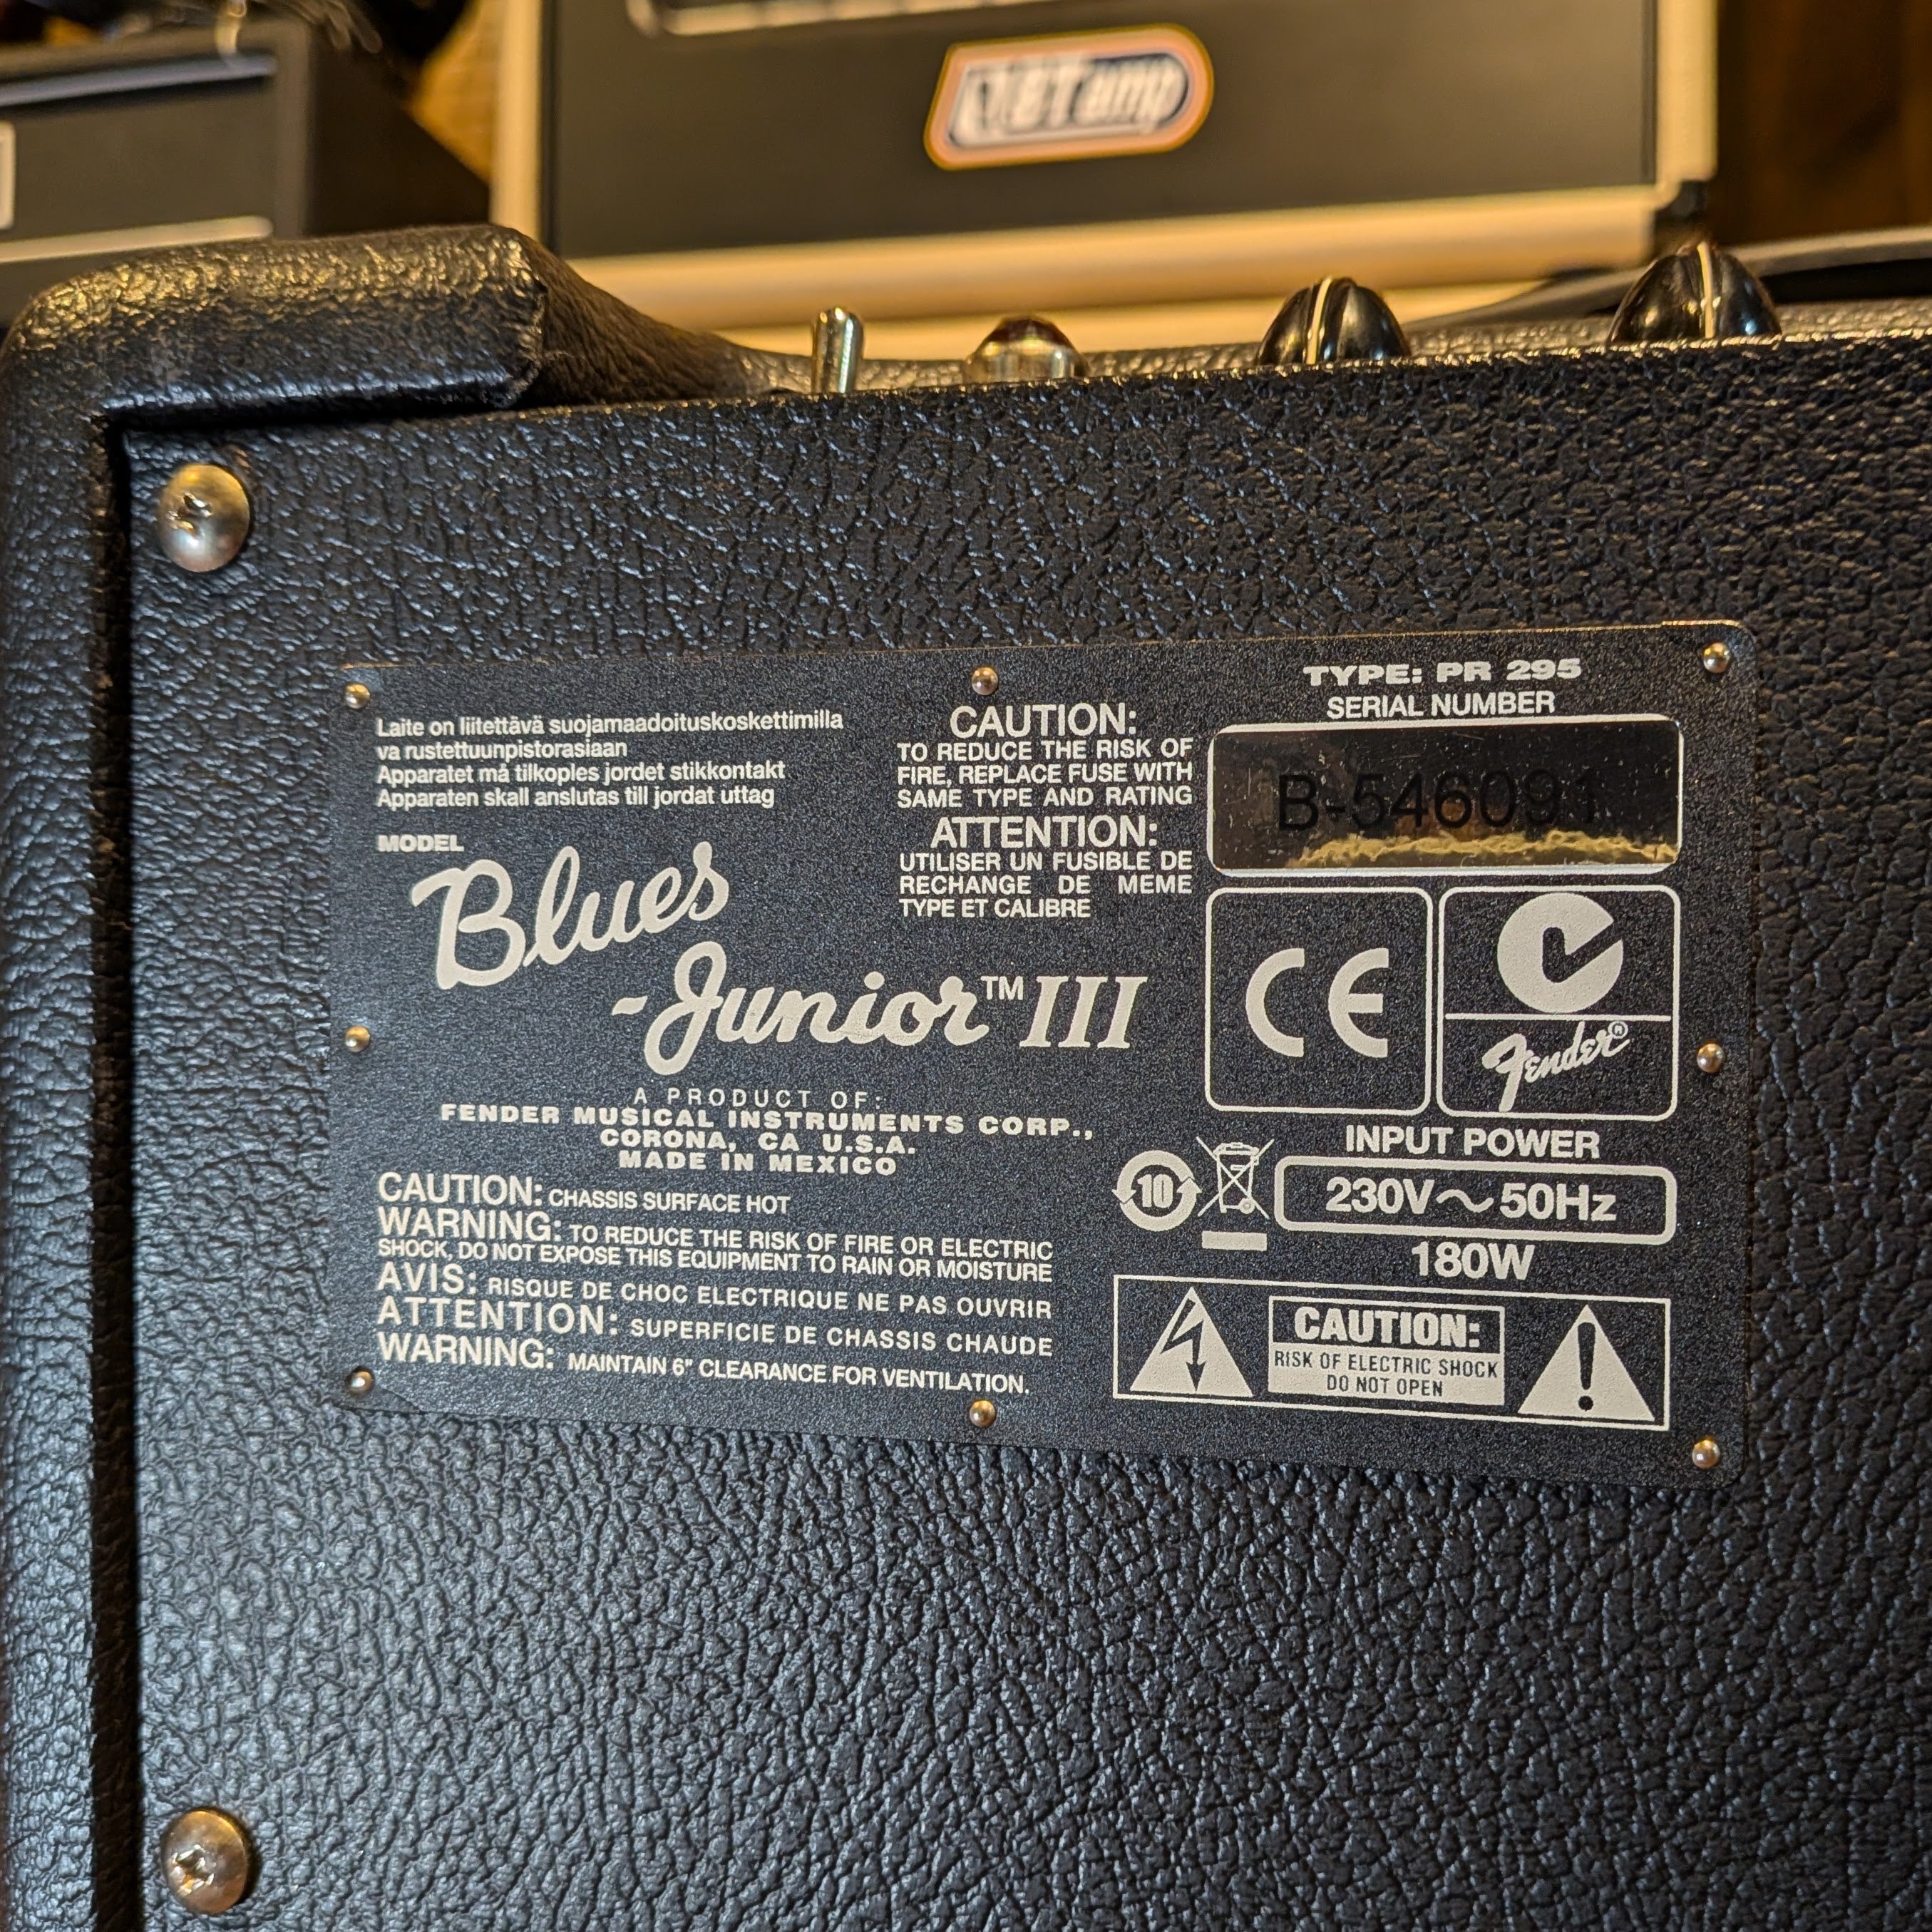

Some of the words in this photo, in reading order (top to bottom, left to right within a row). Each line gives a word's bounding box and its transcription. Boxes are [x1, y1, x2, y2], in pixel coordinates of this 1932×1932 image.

[1303, 664, 1422, 686] TYPE:
[1437, 662, 1491, 682] PR
[1507, 659, 1581, 680] 295
[1327, 695, 1423, 719] SERIAL
[1432, 691, 1555, 716] NUMBER
[376, 718, 424, 737] Laite
[428, 721, 454, 736] on
[460, 715, 544, 735] liitettävä
[549, 709, 843, 740] suojamaadoituskoskettimilla
[950, 703, 1136, 738] CAUTION:
[376, 746, 401, 760] va
[404, 737, 627, 764] rustettuunpistorasiaan
[898, 743, 928, 761] TO
[937, 741, 1032, 761] REDUCE
[1041, 741, 1086, 759] THE
[1097, 739, 1151, 759] RISK
[1161, 738, 1193, 758] OF
[376, 765, 473, 788] Apparatet
[478, 763, 510, 782] må
[515, 764, 600, 786] tilkoples
[603, 762, 664, 786] jordet
[670, 760, 785, 781] stikkontakt
[898, 766, 952, 787] FIRE,
[959, 764, 1061, 784] REPLACE
[1069, 763, 1127, 783] FUSE
[1134, 761, 1192, 781] WITH
[376, 789, 478, 811] Apparaten
[484, 787, 529, 806] skall
[534, 787, 620, 806] anslutas
[625, 786, 648, 805] till
[653, 786, 714, 809] jordat
[721, 786, 774, 808] uttag
[898, 789, 962, 808] SAME
[973, 788, 1032, 807] TYPE
[1044, 788, 1093, 806] AND
[1106, 786, 1192, 805] RATING
[1278, 769, 1595, 833] B-546091
[377, 834, 464, 852] MODEL
[931, 815, 1157, 848] ATTENTION:
[900, 852, 1000, 872] UTILISER
[1010, 852, 1042, 871] UN
[1053, 851, 1150, 870] FUSIBLE
[1161, 851, 1192, 870] DE
[900, 875, 1031, 895] RECHANGE
[1059, 875, 1090, 894] DE
[1119, 875, 1191, 894] MEME
[411, 840, 729, 990] Blues
[899, 899, 955, 917] TYPE
[962, 898, 988, 918] ET
[995, 898, 1090, 918] CALIBRE
[1018, 976, 1148, 1049] III
[634, 1087, 647, 1104] A
[667, 1087, 810, 1108] PRODUCT
[438, 1104, 560, 1124] FENDER
[572, 1106, 714, 1128] MUSICAL
[728, 1110, 964, 1135] INSTRUMENTS
[979, 1116, 1092, 1140] CORP.,
[600, 1129, 736, 1153] CORONA,
[758, 1132, 799, 1151] CA
[823, 1134, 915, 1153] U.S.A.
[1347, 1125, 1453, 1154] INPUT
[1464, 1128, 1599, 1158] POWER
[619, 1150, 706, 1170] MADE
[721, 1152, 754, 1171] IN
[769, 1154, 896, 1176] MEXICO
[376, 1171, 543, 1207] CAUTION:
[548, 1188, 637, 1209] CHASSIS
[642, 1191, 741, 1213] SURFACE
[746, 1195, 791, 1214] HOT
[376, 1206, 562, 1242] WARNING:
[568, 1224, 598, 1243] TO
[604, 1226, 694, 1247] REDUCE
[699, 1229, 742, 1248] THE
[749, 1230, 800, 1250] RISK
[807, 1233, 837, 1251] OF
[844, 1234, 893, 1254] FIRE
[900, 1236, 933, 1255] OR
[940, 1238, 1052, 1262] ELECTRIC
[456, 1240, 488, 1260] DO
[492, 1243, 535, 1262] NOT
[539, 1244, 622, 1265] EXPOSE
[625, 1247, 673, 1268] THIS
[677, 1250, 801, 1271] EQUIPMENT
[806, 1254, 836, 1273] TO
[842, 1255, 893, 1275] RAIN
[898, 1258, 930, 1277] OR
[937, 1260, 1052, 1282] MOISTURE
[1412, 1242, 1534, 1279] 180W
[374, 1259, 478, 1295] AVIS:
[485, 1277, 573, 1299] RISQUE
[581, 1280, 613, 1300] DE
[620, 1283, 688, 1305] CHOC
[697, 1285, 848, 1310] ELECTRIQUE
[858, 1293, 889, 1312] NE
[900, 1295, 947, 1315] PAS
[957, 1297, 1051, 1319] OUVRIR
[377, 1295, 618, 1336] ATTENTION:
[630, 1318, 776, 1344] SUPERFICIE
[785, 1325, 816, 1345] DE
[827, 1327, 936, 1351] CHASSIS
[947, 1332, 1052, 1356] CHAUDE
[1294, 1306, 1481, 1348] CAUTION:
[377, 1328, 554, 1370] WARNING:
[567, 1352, 667, 1377] MAINTAIN
[699, 1359, 827, 1384] CLEARANCE
[832, 1365, 876, 1386] FOR
[882, 1368, 1029, 1394] VENTILATION.
[1275, 1350, 1312, 1368] RISK
[1320, 1353, 1341, 1370] OF
[1348, 1355, 1432, 1375] ELECTRIC
[1438, 1360, 1499, 1379] SHOCK
[1327, 1375, 1349, 1392] DO
[1356, 1377, 1389, 1395] NOT
[1396, 1379, 1444, 1397] OPEN
